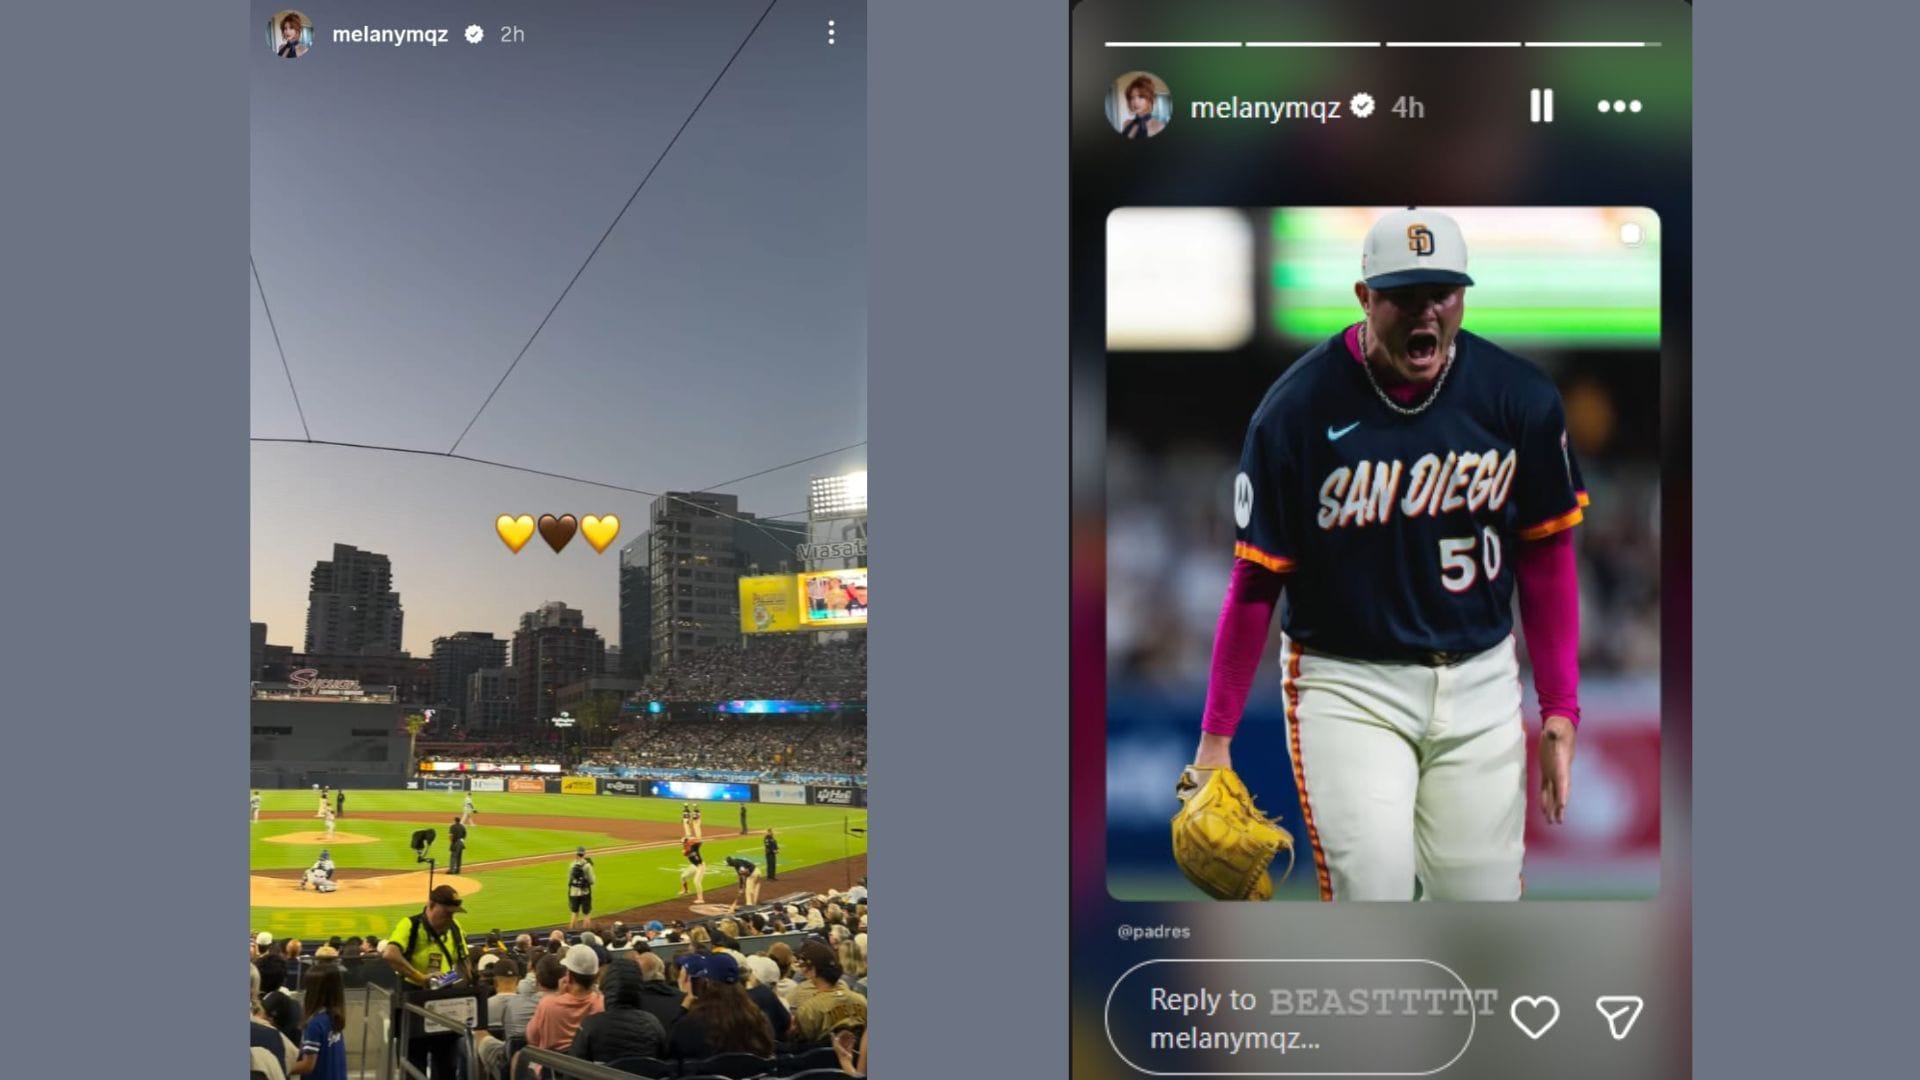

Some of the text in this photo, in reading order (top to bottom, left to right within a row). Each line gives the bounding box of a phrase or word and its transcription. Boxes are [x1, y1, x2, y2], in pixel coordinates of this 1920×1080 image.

[1317, 447, 1516, 530] SAN DIEGO
[1438, 525, 1501, 592] 50
